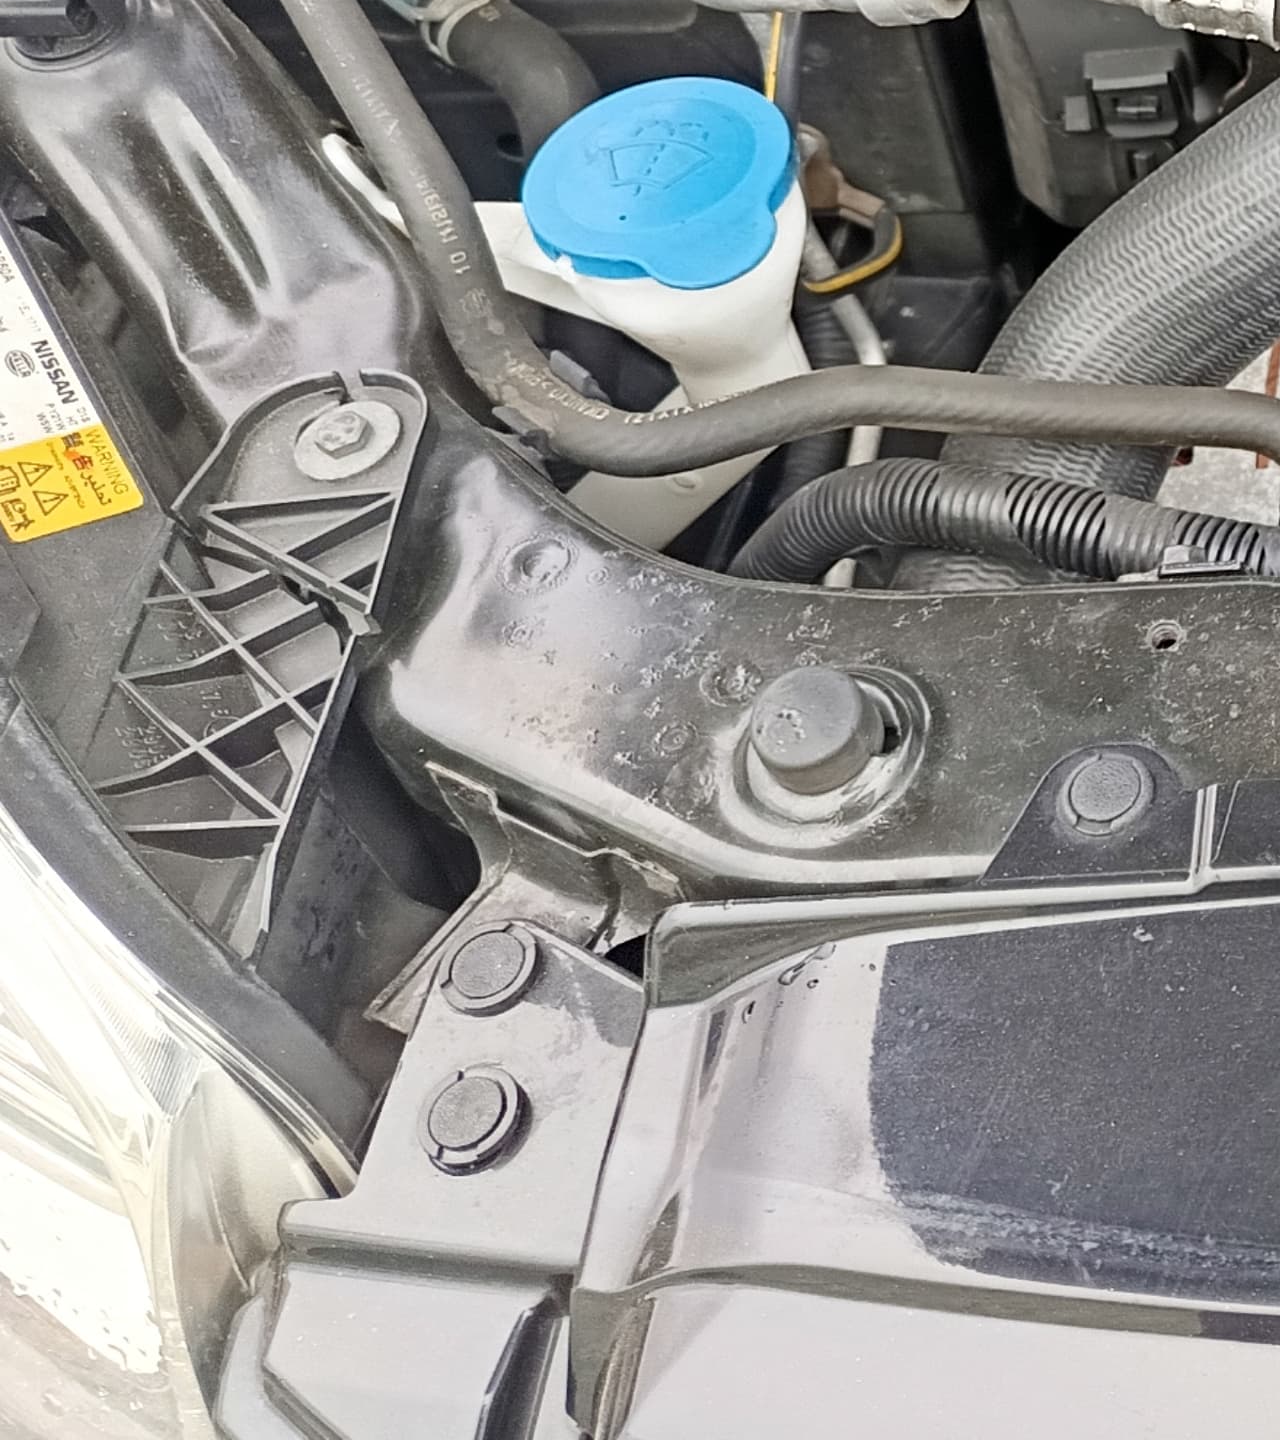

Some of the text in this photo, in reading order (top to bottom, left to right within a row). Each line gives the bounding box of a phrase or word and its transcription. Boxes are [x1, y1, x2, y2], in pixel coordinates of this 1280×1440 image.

[450, 250, 471, 275] 10
[8, 350, 33, 378] HELLA
[31, 340, 79, 405] NISSAN
[36, 412, 54, 433] W5W
[84, 428, 129, 495] WARNING
